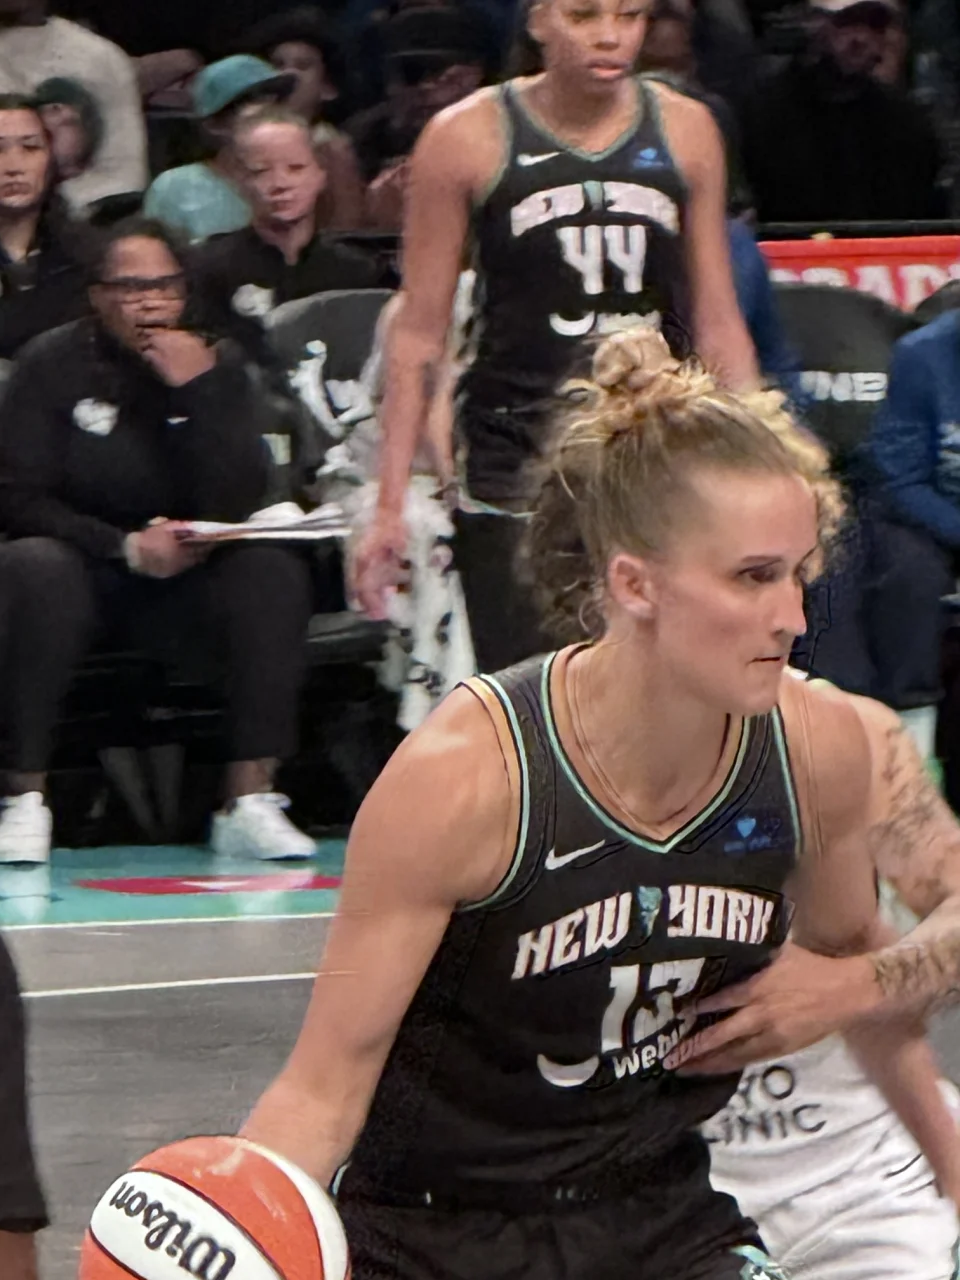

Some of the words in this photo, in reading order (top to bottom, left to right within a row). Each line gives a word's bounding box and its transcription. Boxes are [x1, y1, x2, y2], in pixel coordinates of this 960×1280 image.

[556, 224, 648, 295] 44
[511, 891, 632, 980] NEW
[667, 884, 775, 945] YORK
[600, 957, 705, 1054] 13
